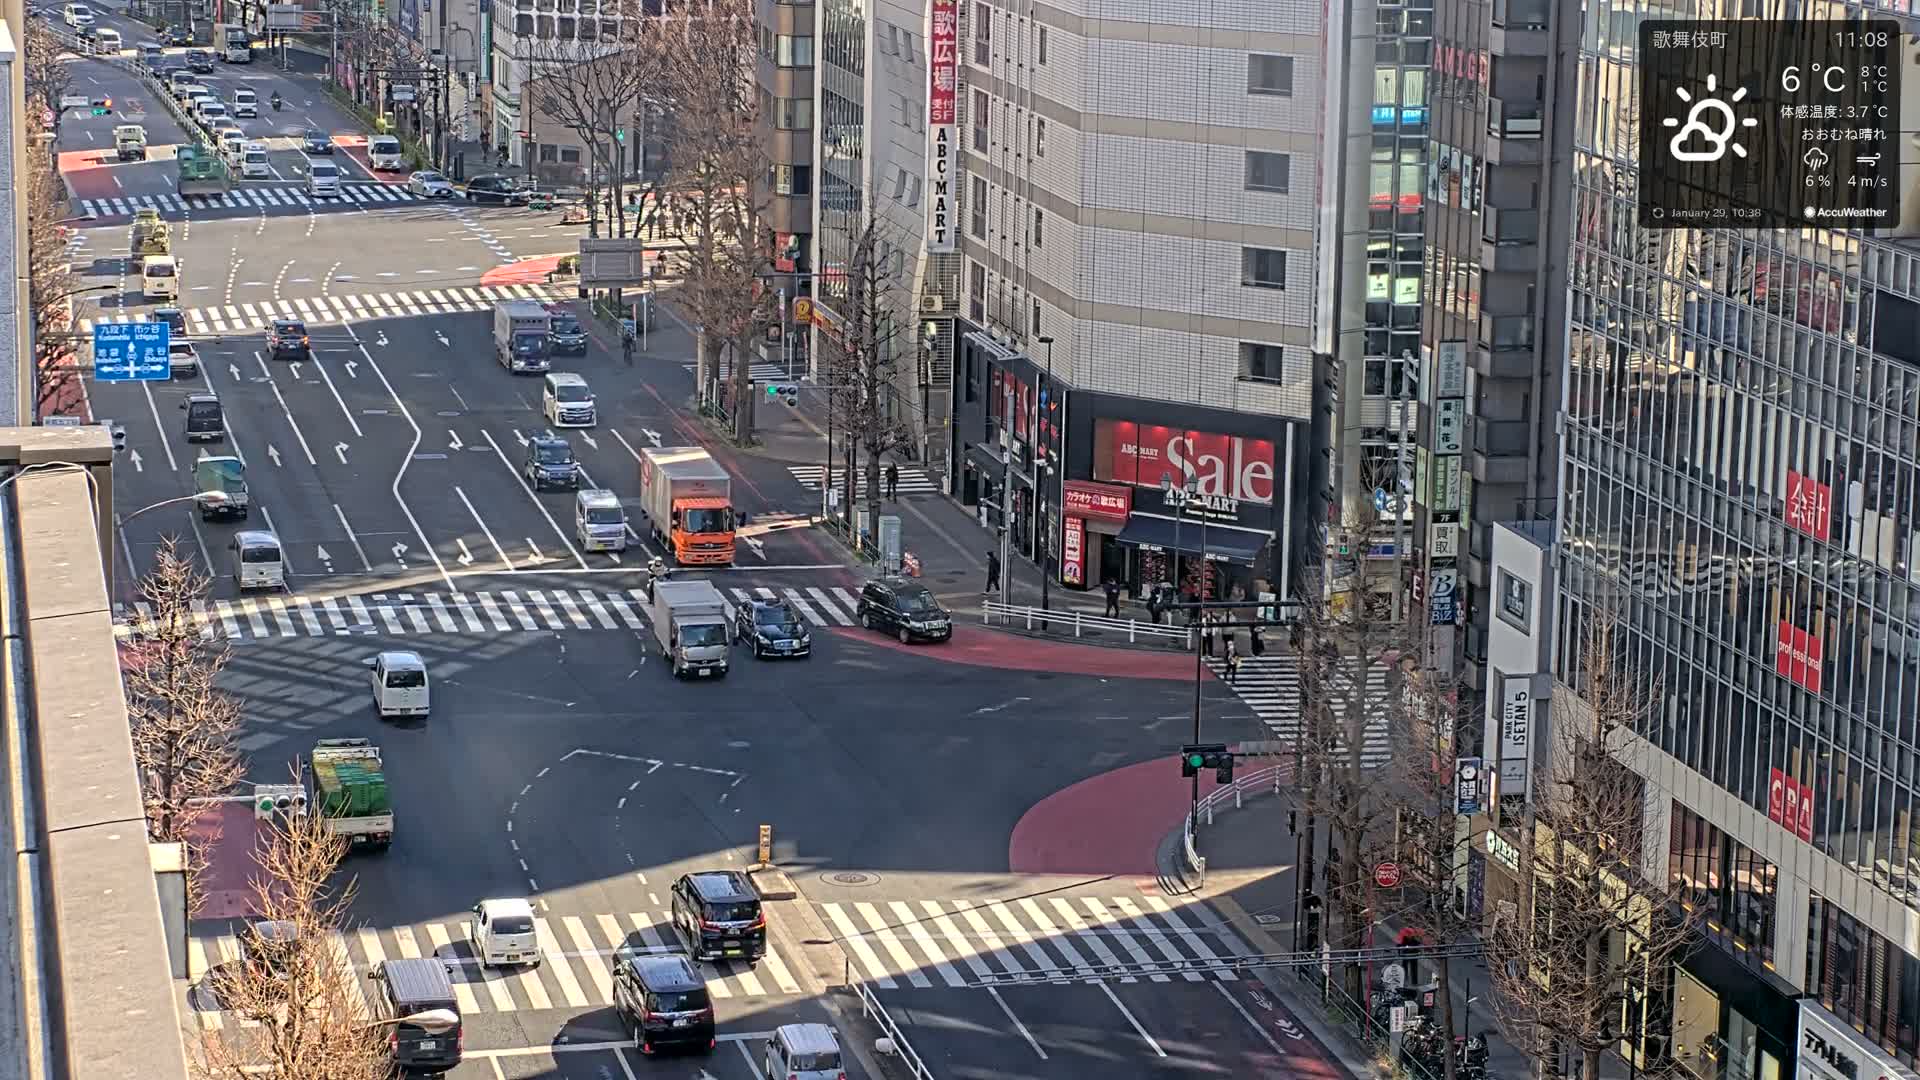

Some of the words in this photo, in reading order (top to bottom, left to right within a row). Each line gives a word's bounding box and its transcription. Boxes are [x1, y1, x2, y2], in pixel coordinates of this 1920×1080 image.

[933, 10, 955, 91] 歌広場
[935, 128, 948, 243] ABC-MART
[1167, 435, 1273, 506] Sale
[1440, 514, 1450, 522] 7F
[1790, 481, 1826, 530] 会計
[1435, 526, 1449, 554] 買取
[1778, 641, 1822, 671] professional
[1506, 702, 1514, 719] CITY
[1515, 691, 1527, 701] 5
[1504, 720, 1513, 739] PARK
[1513, 705, 1527, 746] ISETAN
[1772, 779, 1810, 829] CPA
